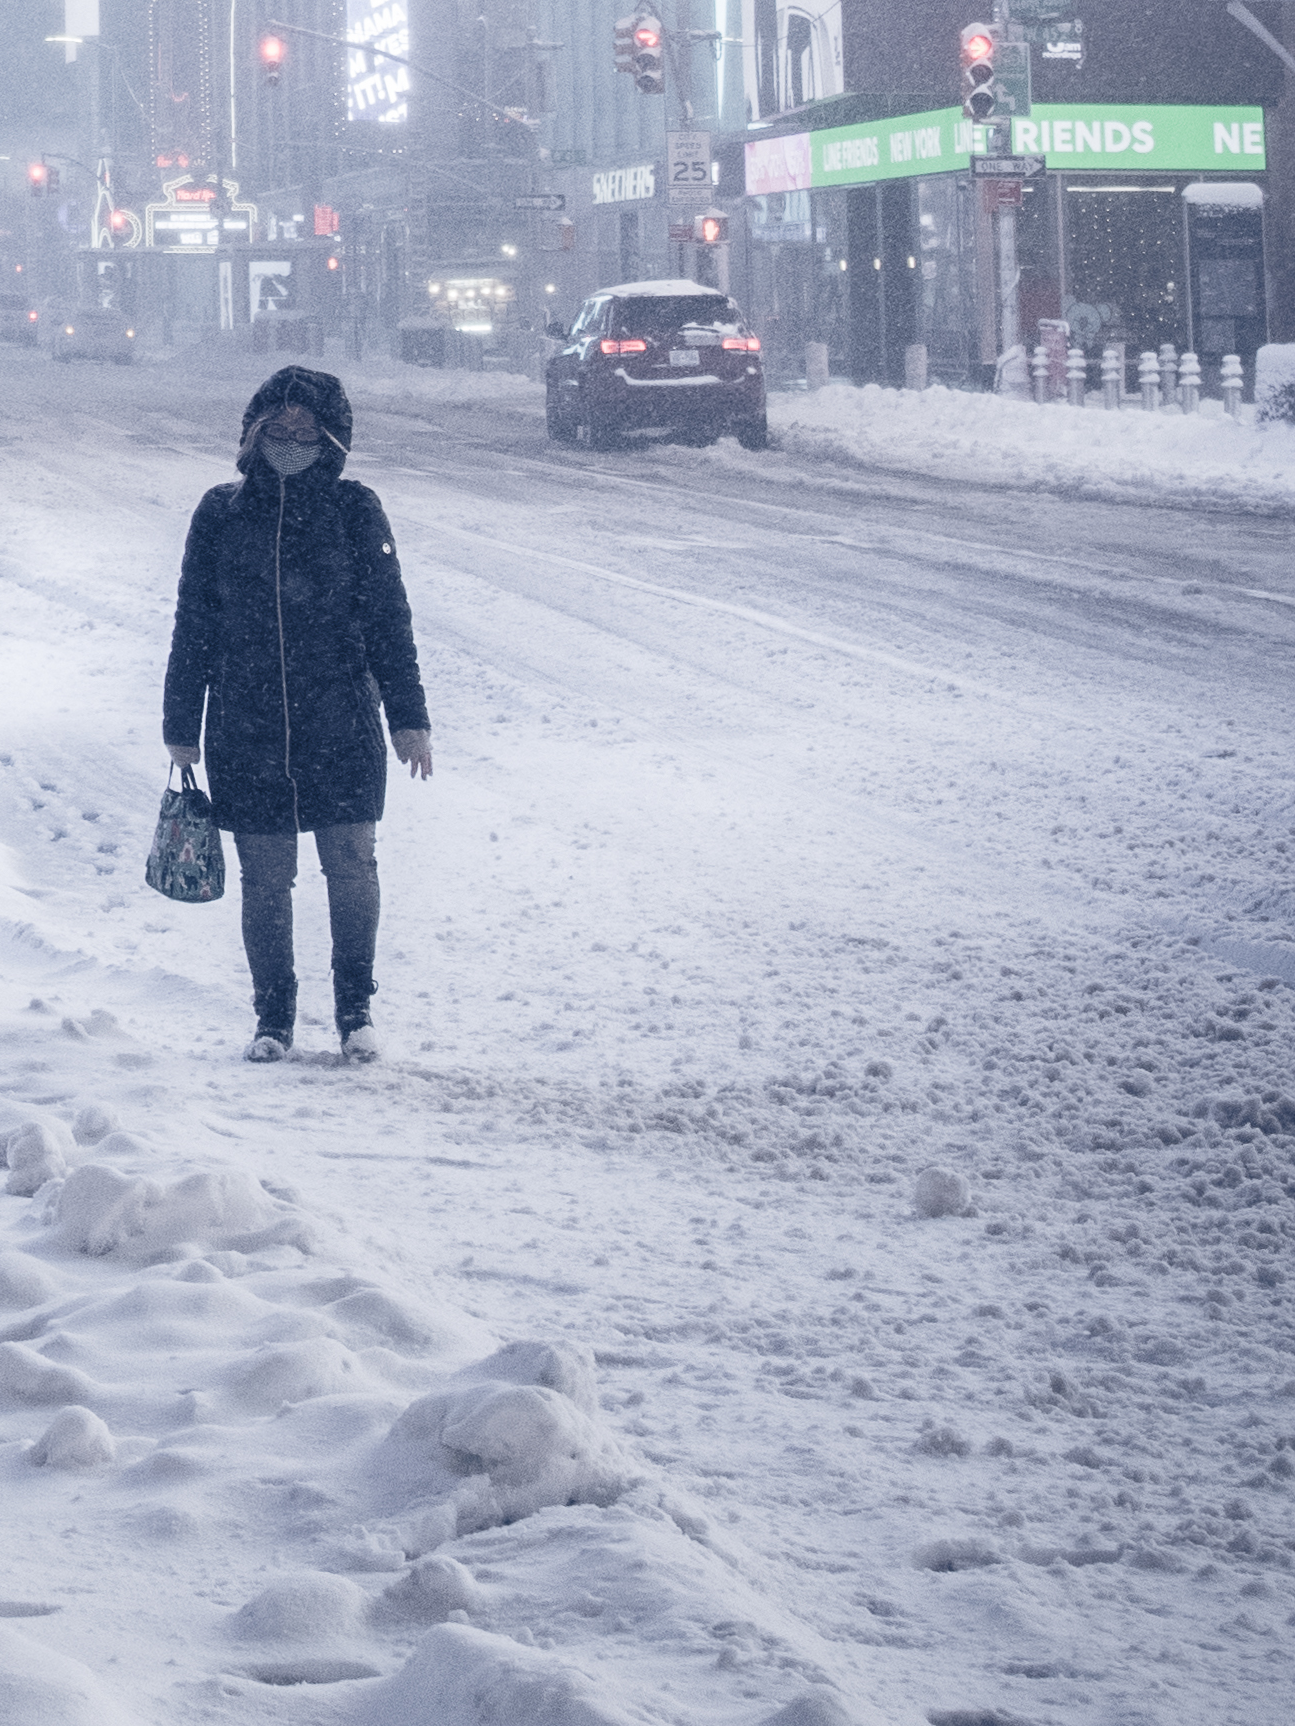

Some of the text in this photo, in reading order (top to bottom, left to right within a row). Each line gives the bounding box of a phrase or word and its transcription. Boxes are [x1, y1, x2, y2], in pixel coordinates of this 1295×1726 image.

[346, 2, 407, 44] MAMA
[350, 29, 409, 79] MKES
[353, 73, 386, 110] IT!
[823, 143, 842, 172] LINE
[842, 135, 879, 169] FRIENDS
[889, 125, 942, 164] NEW YORK
[1014, 119, 1155, 154] RIENDS
[1213, 120, 1264, 155] NE
[592, 164, 655, 205] SKECHERS
[673, 160, 707, 182] 25
[980, 160, 1003, 173] ONE
